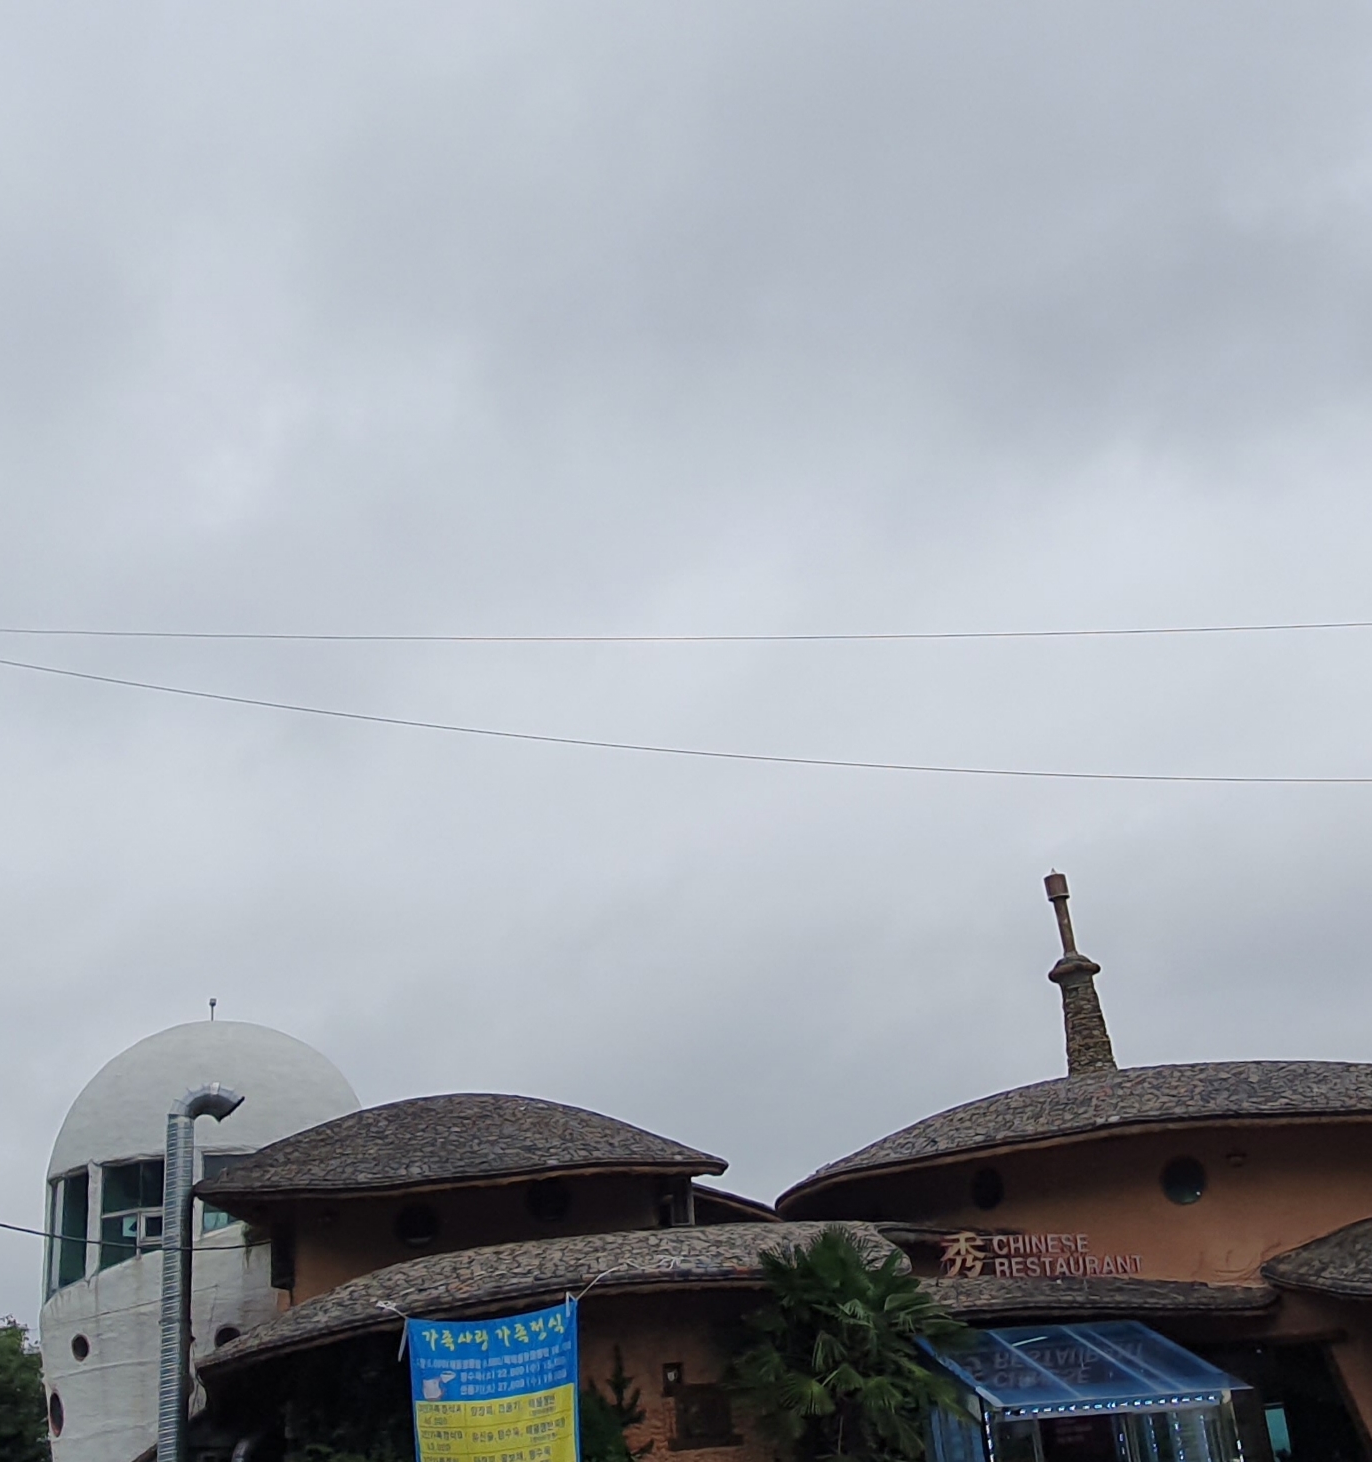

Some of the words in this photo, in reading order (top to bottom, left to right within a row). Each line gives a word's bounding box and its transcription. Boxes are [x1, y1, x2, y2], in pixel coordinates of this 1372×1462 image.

[940, 1231, 987, 1278] 秀
[992, 1233, 1090, 1255] CHINESE
[994, 1254, 1143, 1278] RESTAURANT
[421, 1328, 489, 1352] 가족사랑
[494, 1313, 565, 1347] 가족정식
